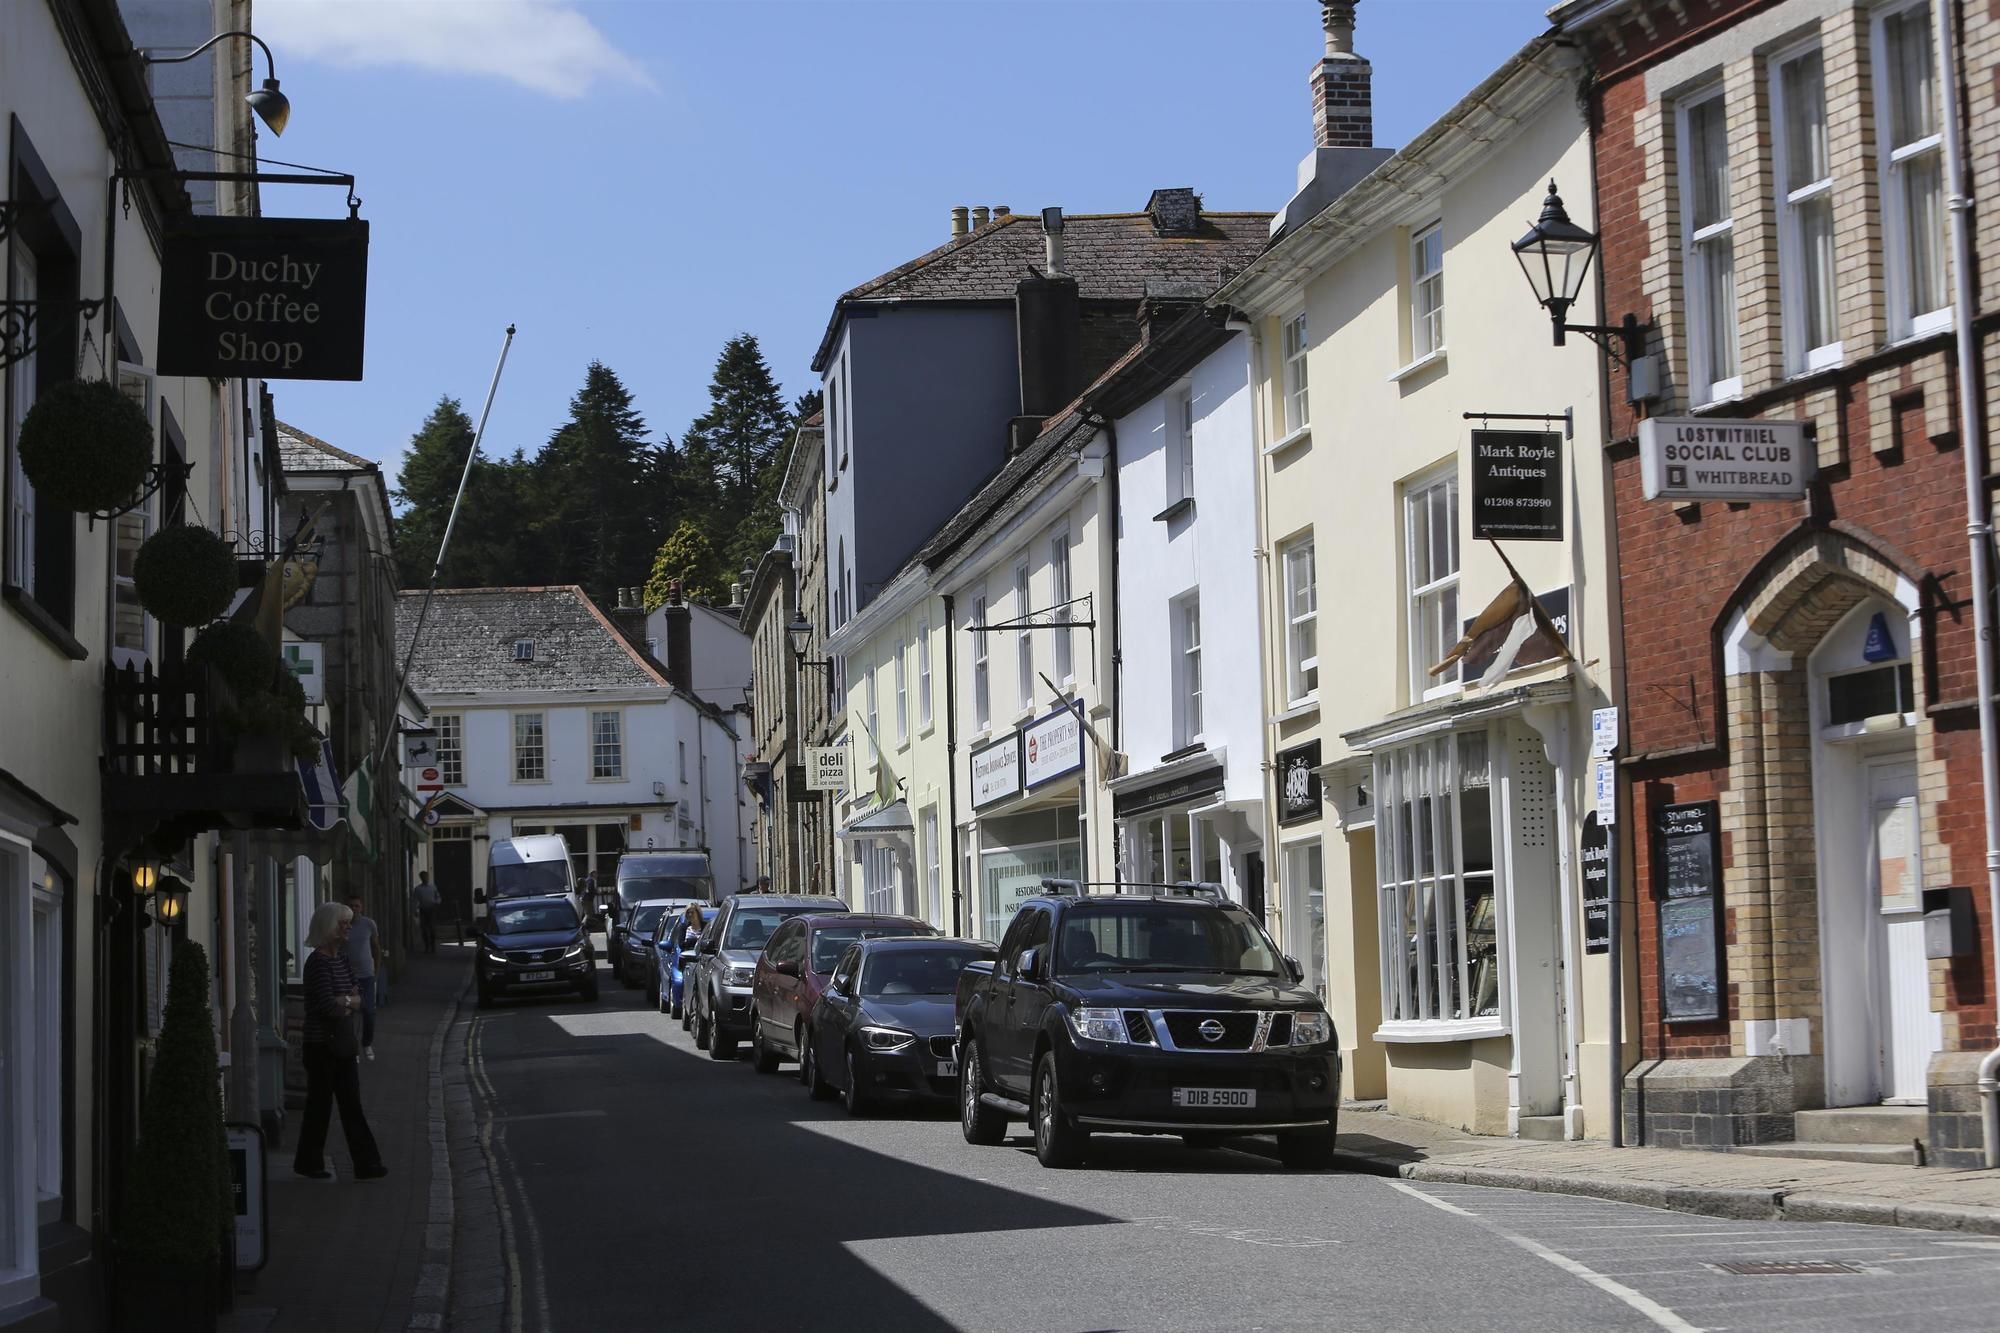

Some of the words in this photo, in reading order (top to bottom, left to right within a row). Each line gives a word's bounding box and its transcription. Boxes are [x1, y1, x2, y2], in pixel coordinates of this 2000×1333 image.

[207, 251, 322, 290] Duchy
[205, 291, 320, 324] Coffee
[218, 331, 303, 369] Shop
[1677, 427, 1777, 444] LOSTWITHIEL
[1479, 445, 1515, 457] Mark
[1518, 446, 1556, 461] Royle
[1665, 445, 1735, 461] SOCIAL
[1742, 446, 1791, 462] CLUB
[1488, 464, 1547, 479] Antiques
[1695, 470, 1792, 486] WHITBREAD
[1484, 497, 1514, 507] 01208
[1516, 498, 1551, 507] 873990
[1048, 724, 1068, 748] PROPERTY
[820, 752, 843, 766] deli
[819, 767, 843, 779] pizza
[1015, 885, 1043, 897] RESTORMEL
[1187, 1090, 1208, 1105] DIB
[1212, 1090, 1248, 1106] 5900
